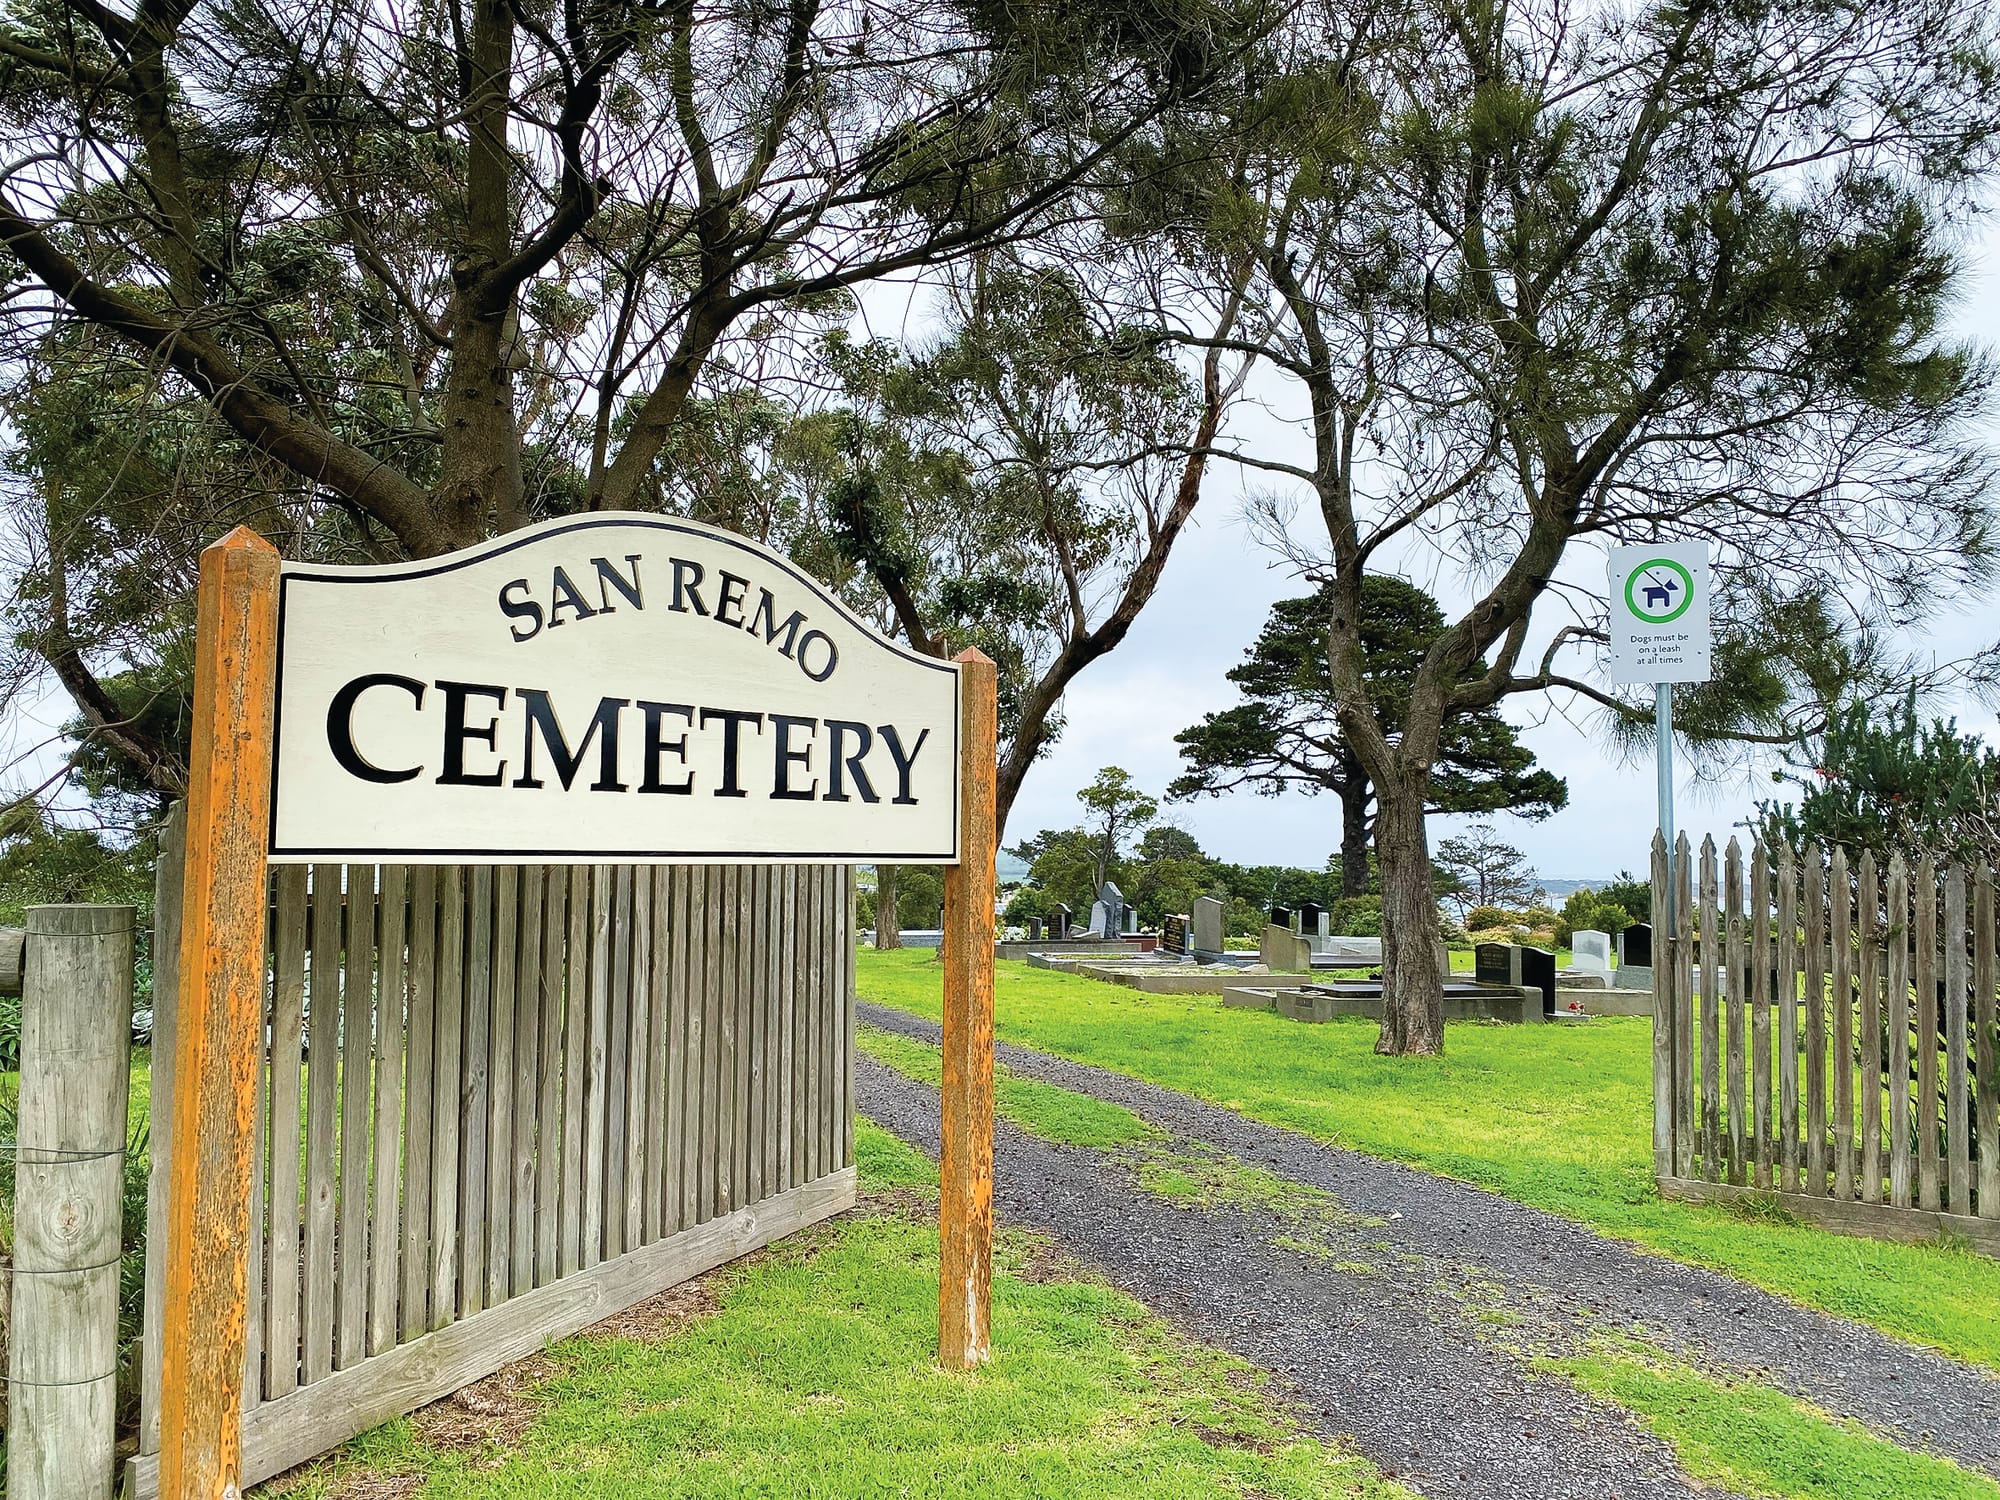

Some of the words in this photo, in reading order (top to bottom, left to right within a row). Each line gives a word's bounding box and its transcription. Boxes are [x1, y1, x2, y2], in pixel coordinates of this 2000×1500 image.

[499, 554, 647, 643] SAN
[668, 556, 840, 683] REMO
[1630, 635, 1652, 645] Dogs
[1654, 634, 1675, 642] must
[1678, 633, 1689, 641] be
[1659, 644, 1681, 653] leash
[1647, 655, 1657, 664] all
[1659, 656, 1683, 664] times
[326, 673, 931, 806] CEMETERY
